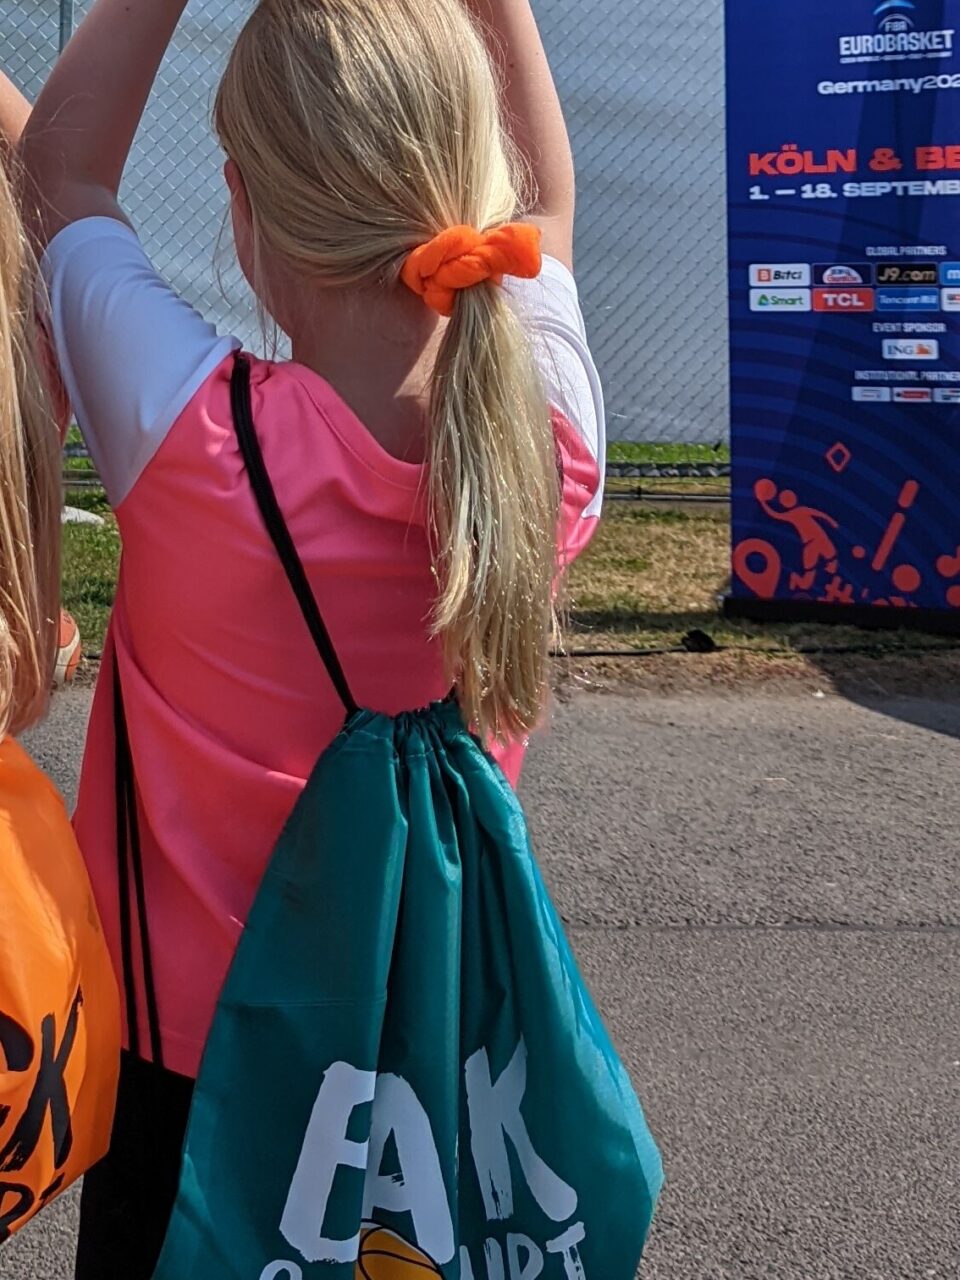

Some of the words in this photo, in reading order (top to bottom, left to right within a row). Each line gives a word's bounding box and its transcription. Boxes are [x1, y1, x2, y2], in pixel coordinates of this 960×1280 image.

[839, 29, 955, 56] EUROBASKET
[748, 143, 858, 175] KÖLN
[868, 147, 903, 171] &
[749, 185, 770, 200] 1.
[801, 183, 838, 199] 18.
[771, 295, 804, 306] Smart
[822, 293, 865, 307] TCL
[887, 345, 914, 355] ING
